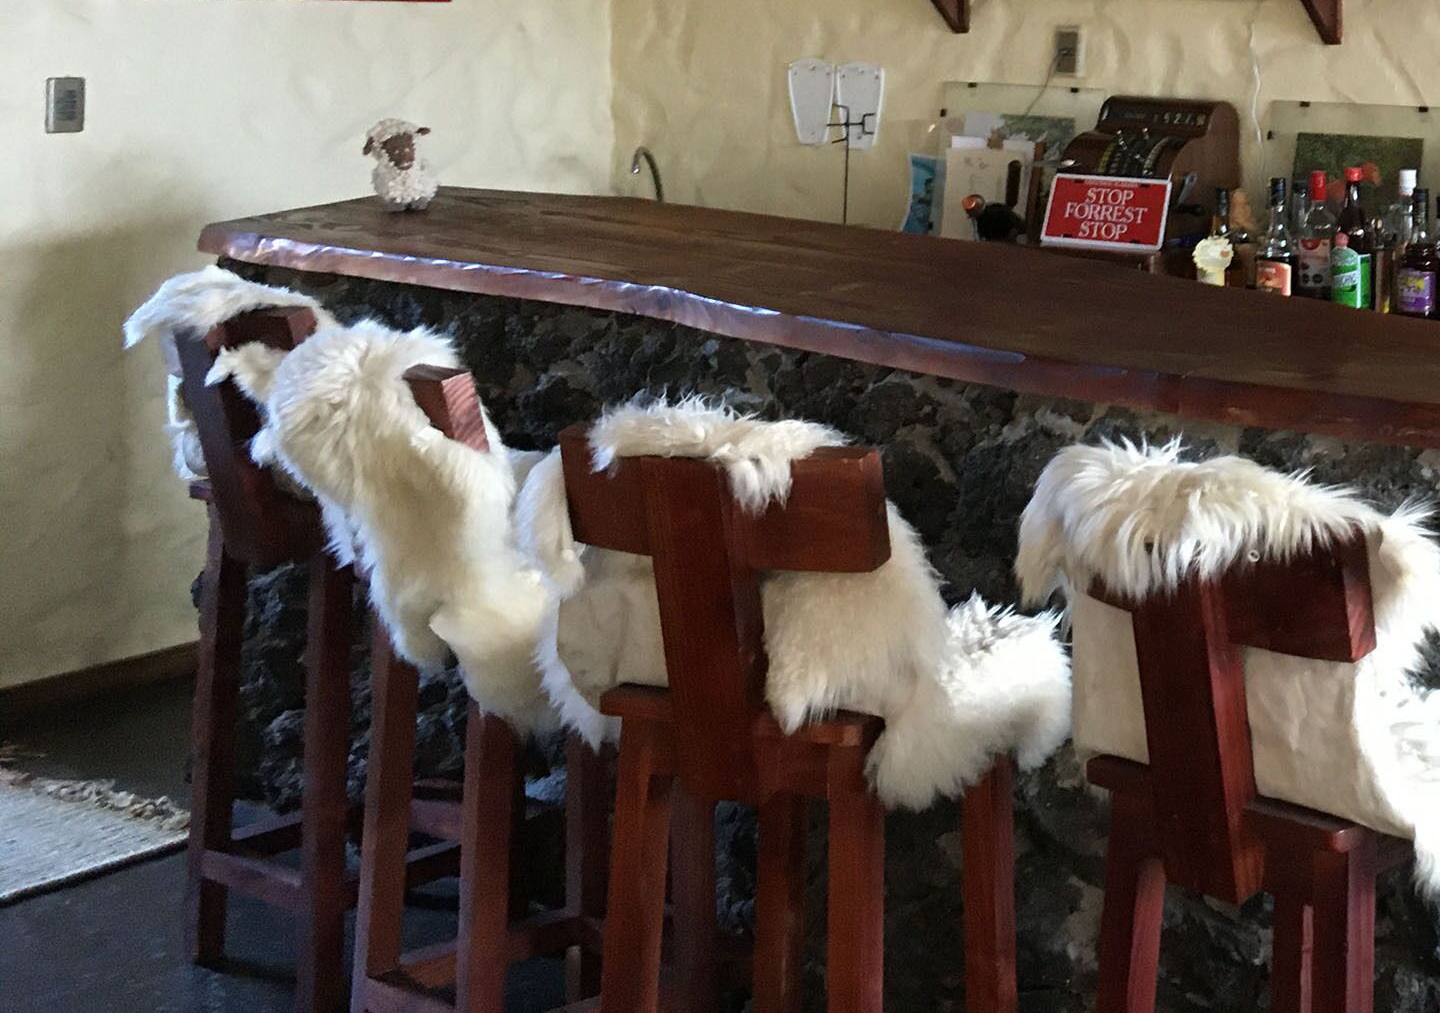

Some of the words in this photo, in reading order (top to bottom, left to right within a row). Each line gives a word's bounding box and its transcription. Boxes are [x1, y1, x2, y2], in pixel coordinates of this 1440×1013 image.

[1085, 187, 1134, 206] STOP
[1064, 202, 1148, 224] FORREST
[1078, 220, 1128, 239] STOP
